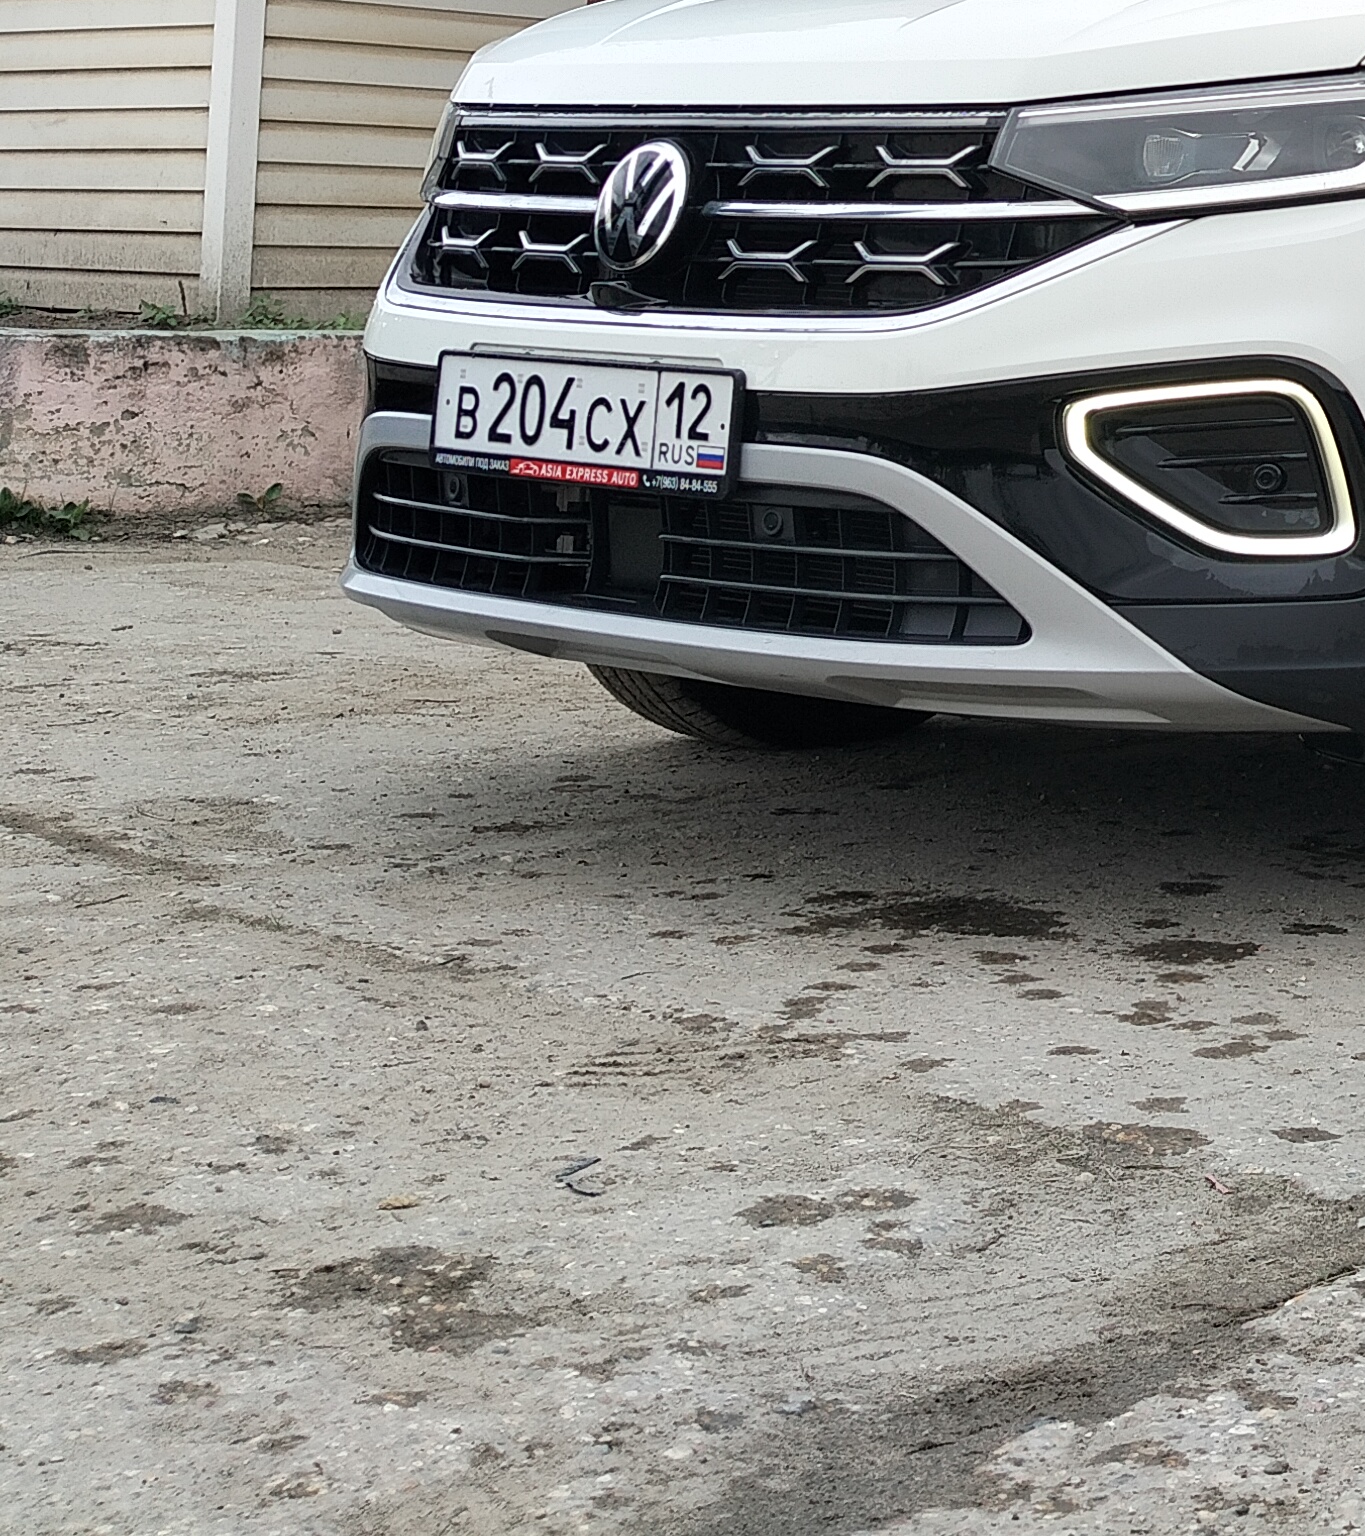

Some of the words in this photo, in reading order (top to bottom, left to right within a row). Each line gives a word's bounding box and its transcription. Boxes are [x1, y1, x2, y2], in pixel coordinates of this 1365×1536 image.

[664, 381, 713, 442] 12
[434, 453, 475, 467] АВТОМОБИЛИ
[475, 456, 489, 470] ПОД
[489, 457, 509, 471] ЗАКАЗ
[658, 443, 696, 466] RUS
[539, 465, 563, 479] ASIA
[565, 467, 609, 483] EXPRESS
[611, 471, 637, 486] AUTO
[679, 478, 718, 493] 84-84-555
